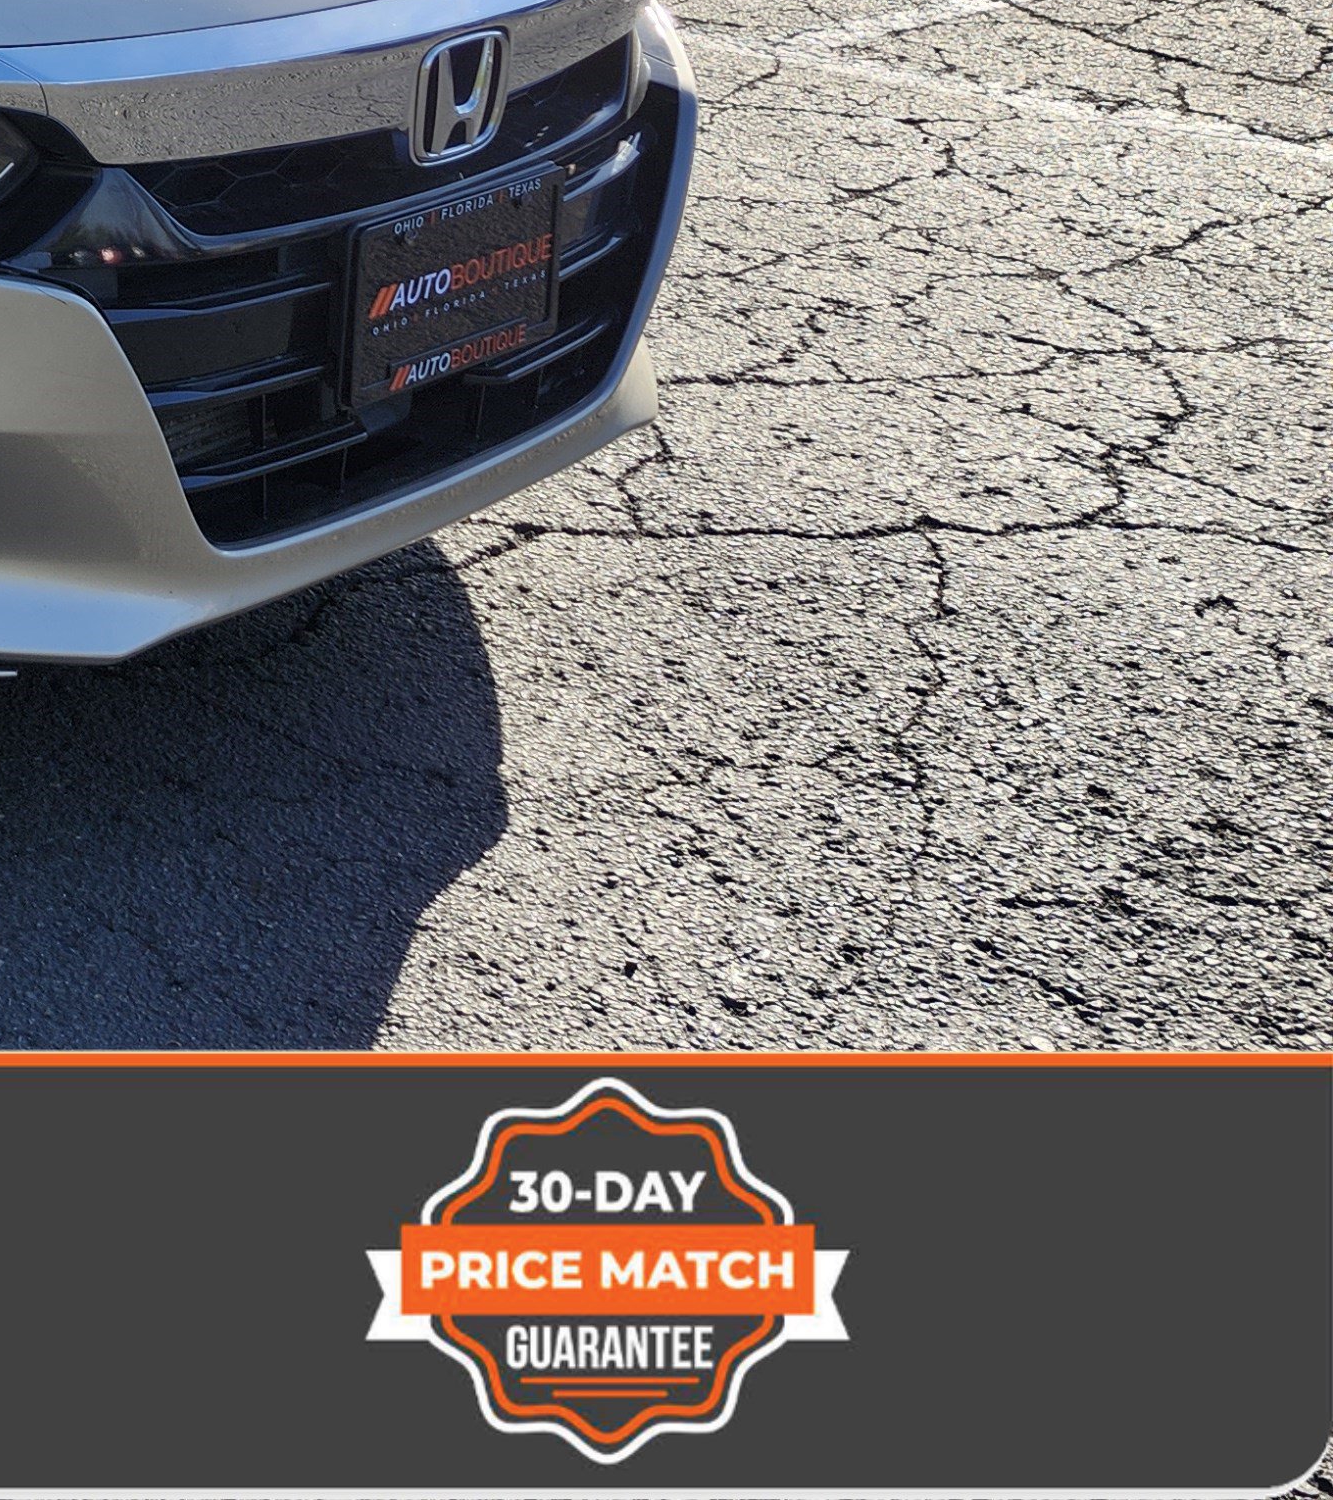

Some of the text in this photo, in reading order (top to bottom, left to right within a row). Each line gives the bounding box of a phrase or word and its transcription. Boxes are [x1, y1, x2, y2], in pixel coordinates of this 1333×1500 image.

[394, 177, 541, 235] OHIO FLORIDA TEXAS
[372, 269, 546, 336] OHIO FLORIDA TEXAS
